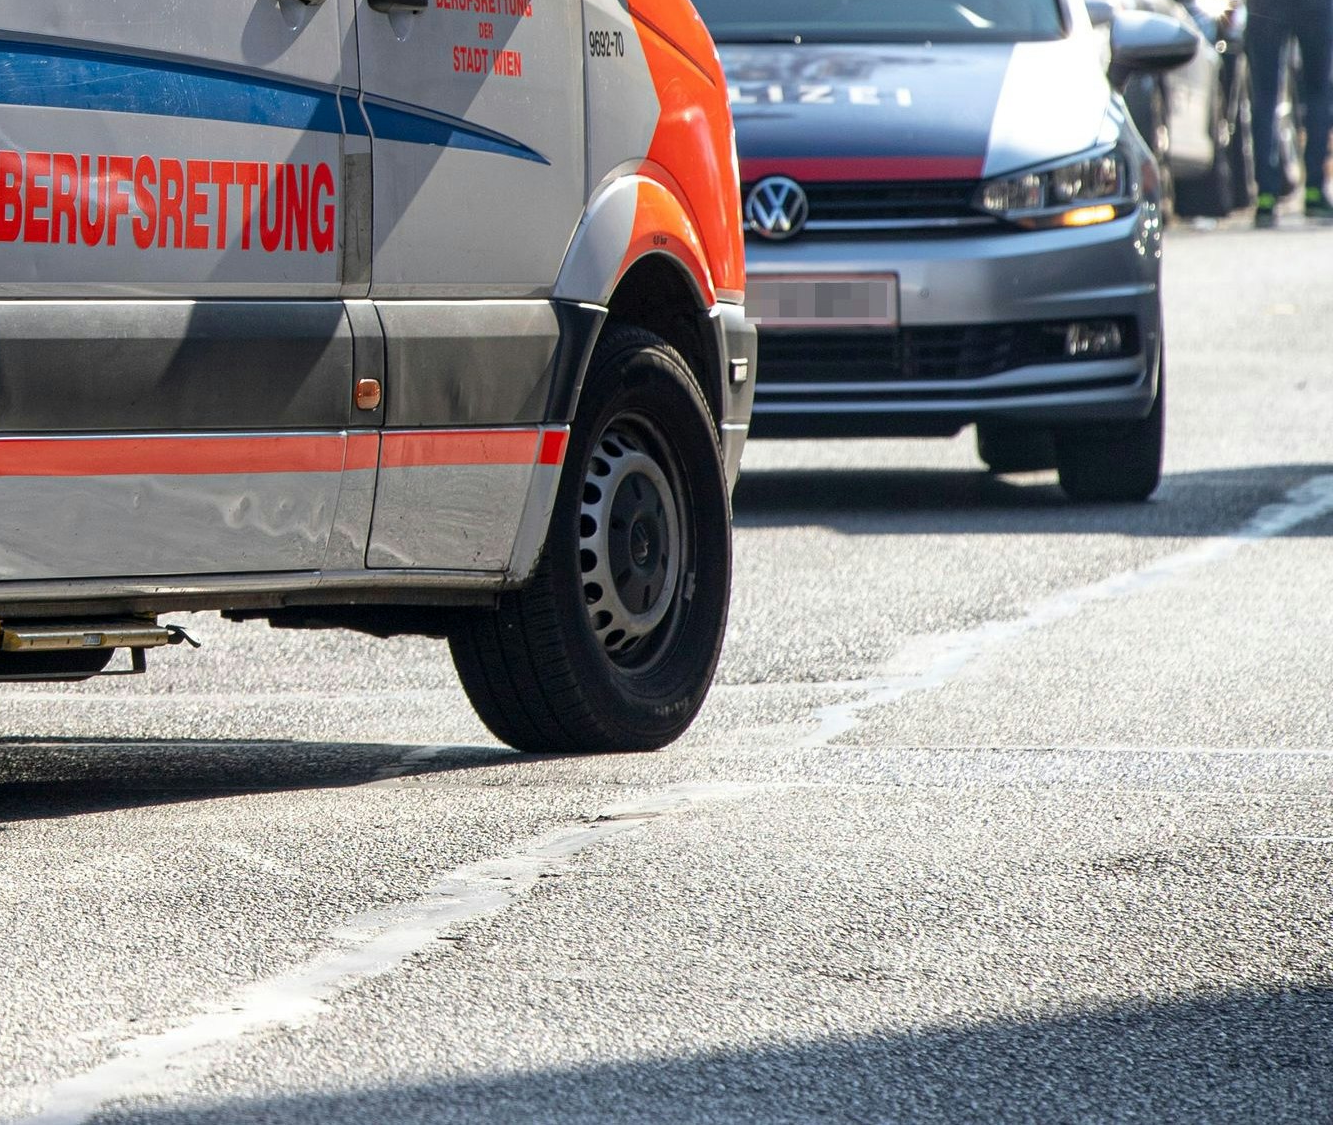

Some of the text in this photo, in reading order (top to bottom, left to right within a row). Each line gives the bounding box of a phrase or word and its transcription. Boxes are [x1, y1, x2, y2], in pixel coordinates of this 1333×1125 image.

[478, 22, 494, 39] DER
[589, 31, 625, 58] 9692-70
[453, 45, 522, 77] STADT WIEN
